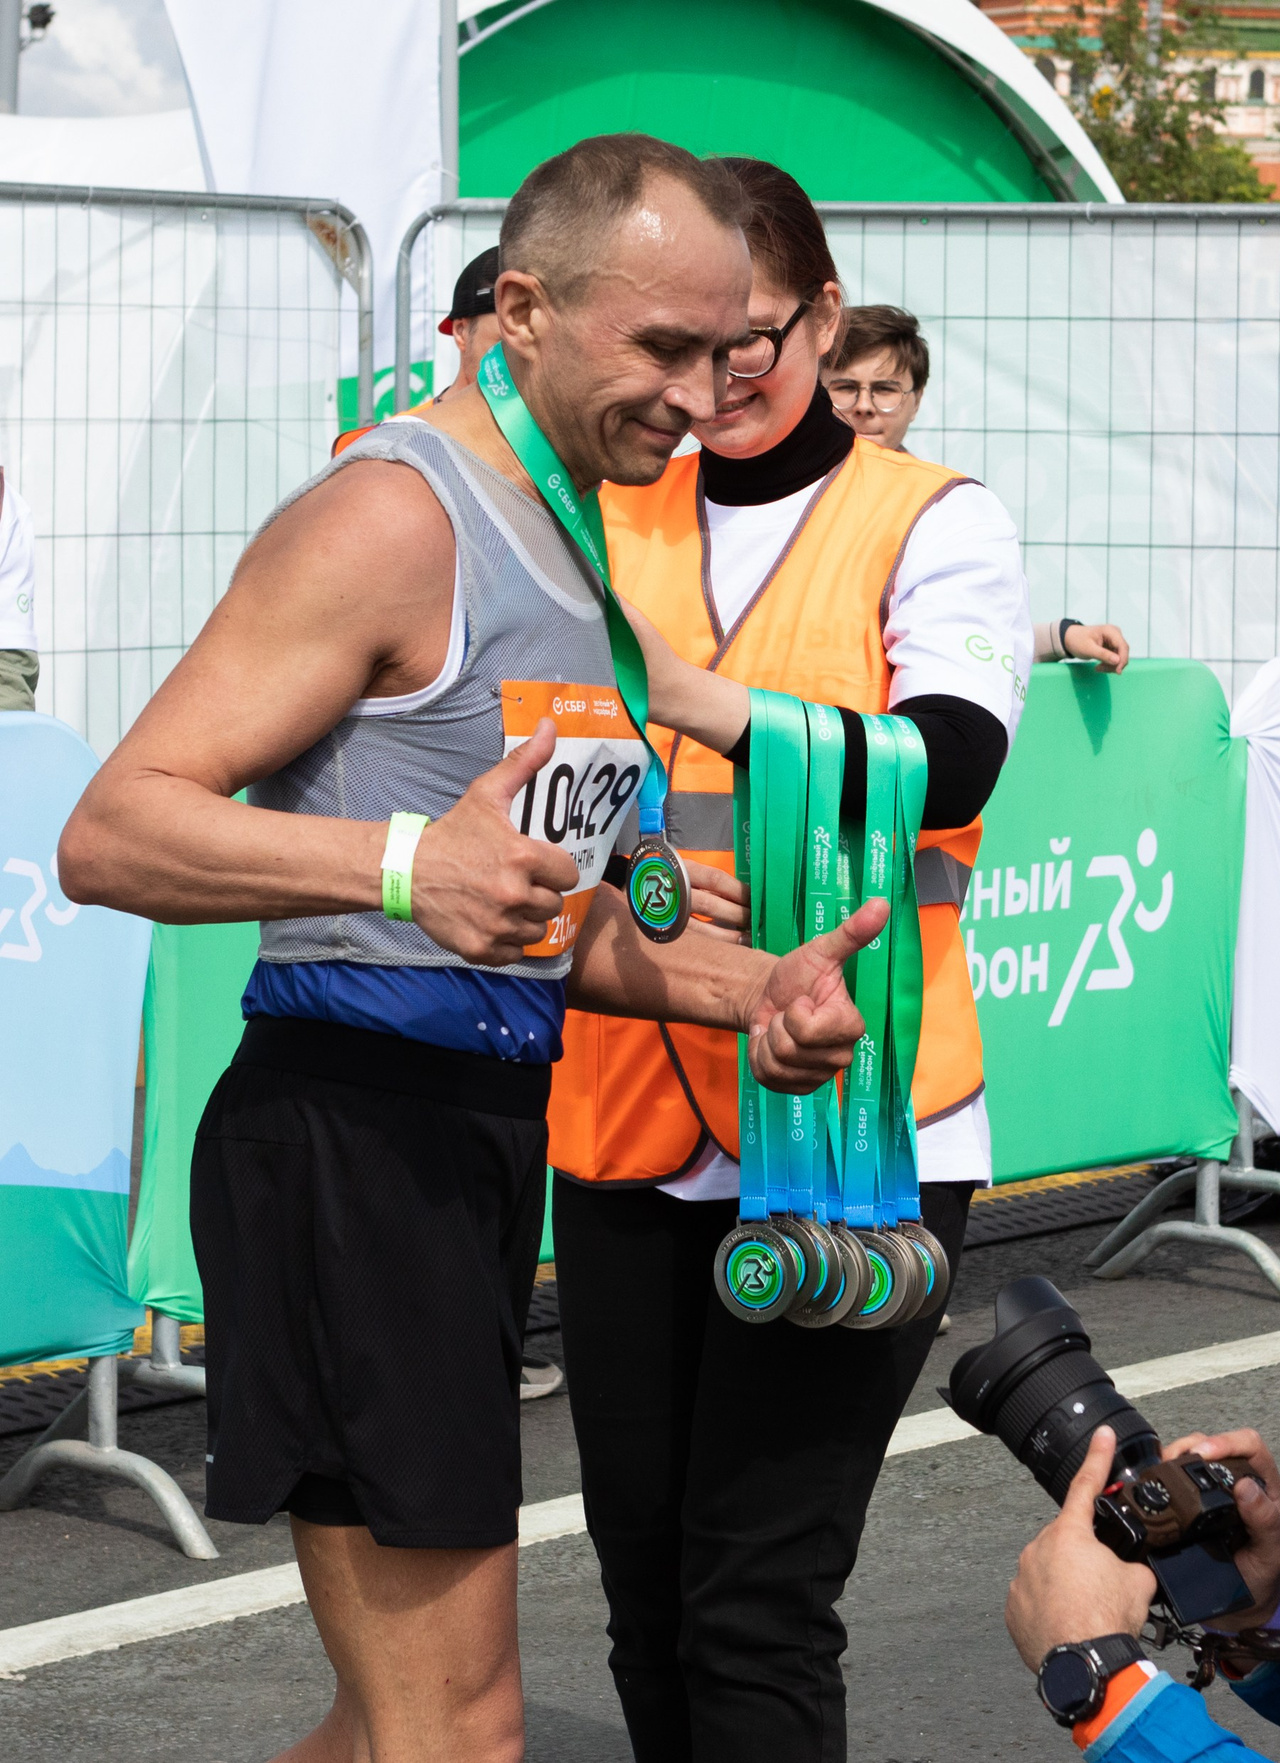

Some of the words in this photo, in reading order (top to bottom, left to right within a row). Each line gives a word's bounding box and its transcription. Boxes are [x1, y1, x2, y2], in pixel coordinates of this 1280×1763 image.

[557, 487, 576, 514] СБЕР
[564, 699, 587, 713] СБЕР
[520, 763, 640, 843] 10429
[813, 845, 821, 880] зелёный
[821, 848, 829, 885] марафон
[959, 836, 1072, 923] ный
[815, 901, 824, 931] СБЕР
[865, 1055, 873, 1091] марафон
[793, 1096, 802, 1126] СБЕР
[858, 1107, 868, 1136] СБЕР
